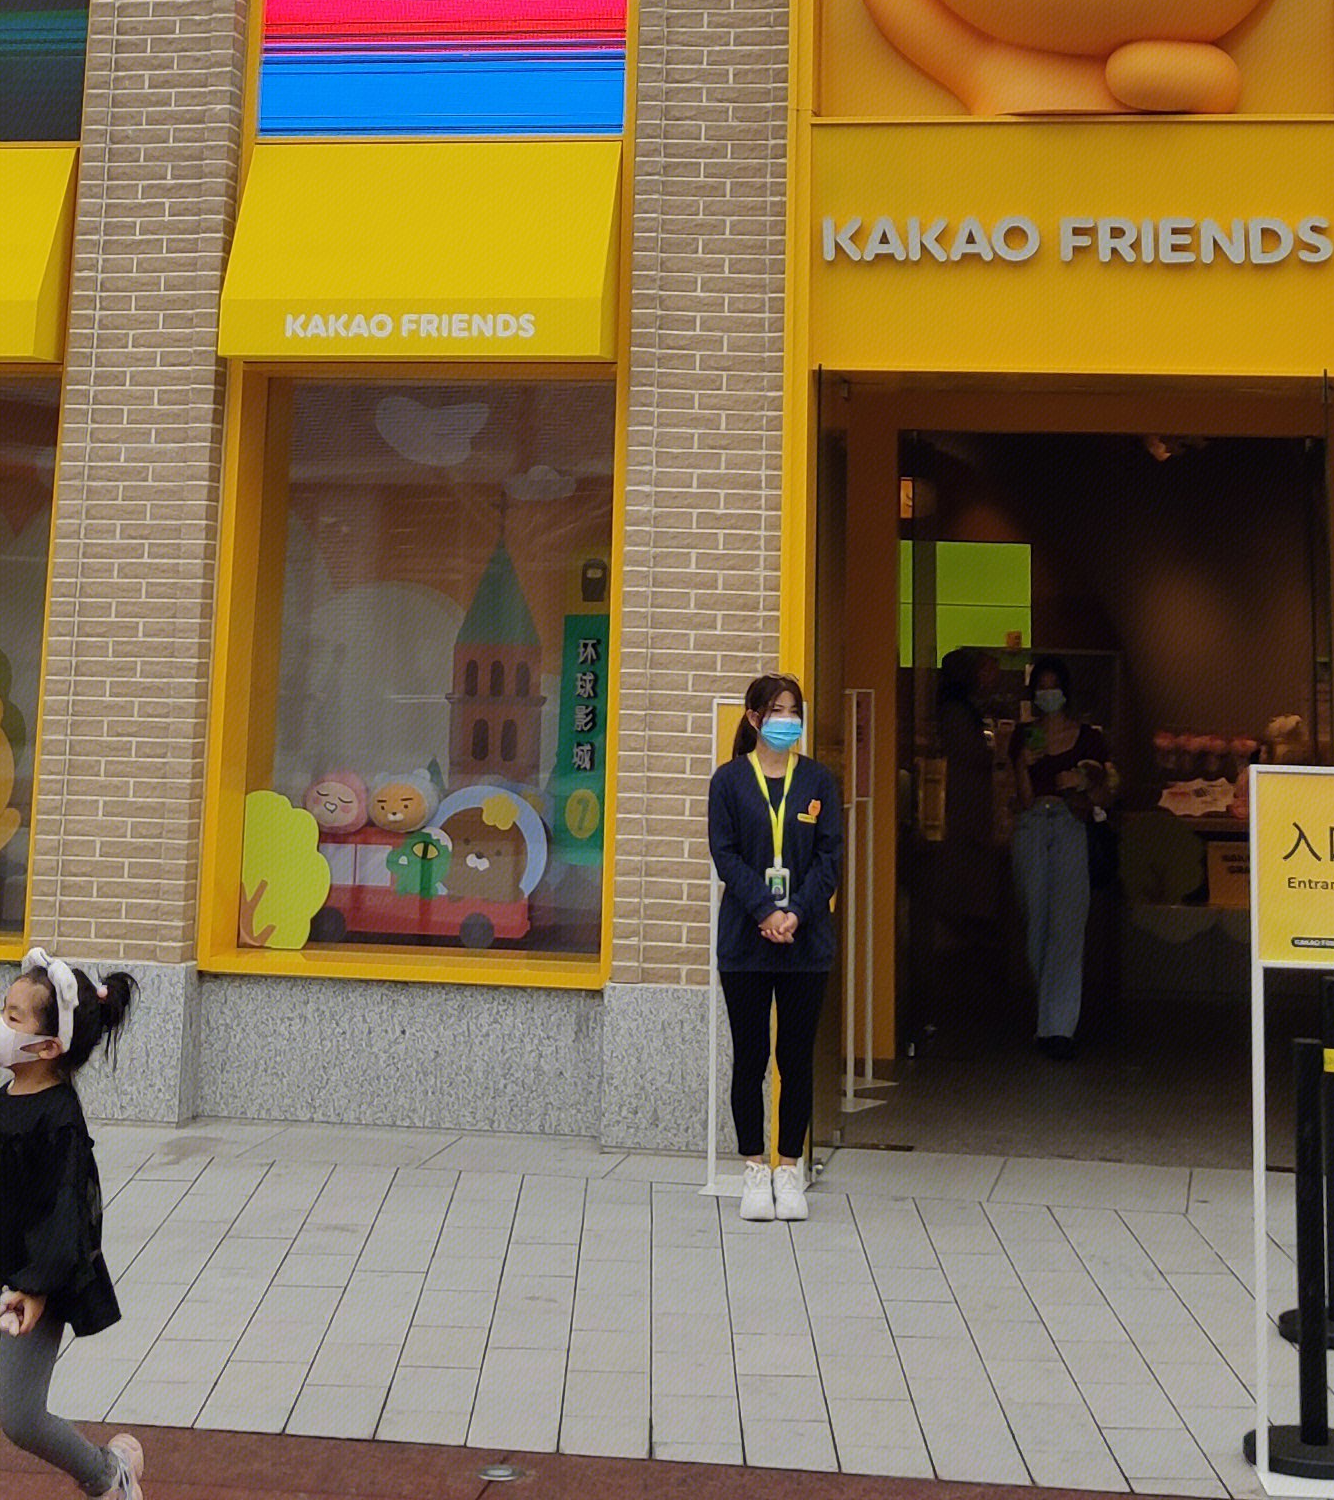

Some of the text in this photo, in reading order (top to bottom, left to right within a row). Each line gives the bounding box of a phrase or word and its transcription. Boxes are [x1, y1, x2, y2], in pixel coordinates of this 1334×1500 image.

[821, 215, 1334, 265] KAKAO FRIENDS
[284, 313, 537, 339] KAKAO FRIENDS
[572, 638, 600, 772] 环球影城
